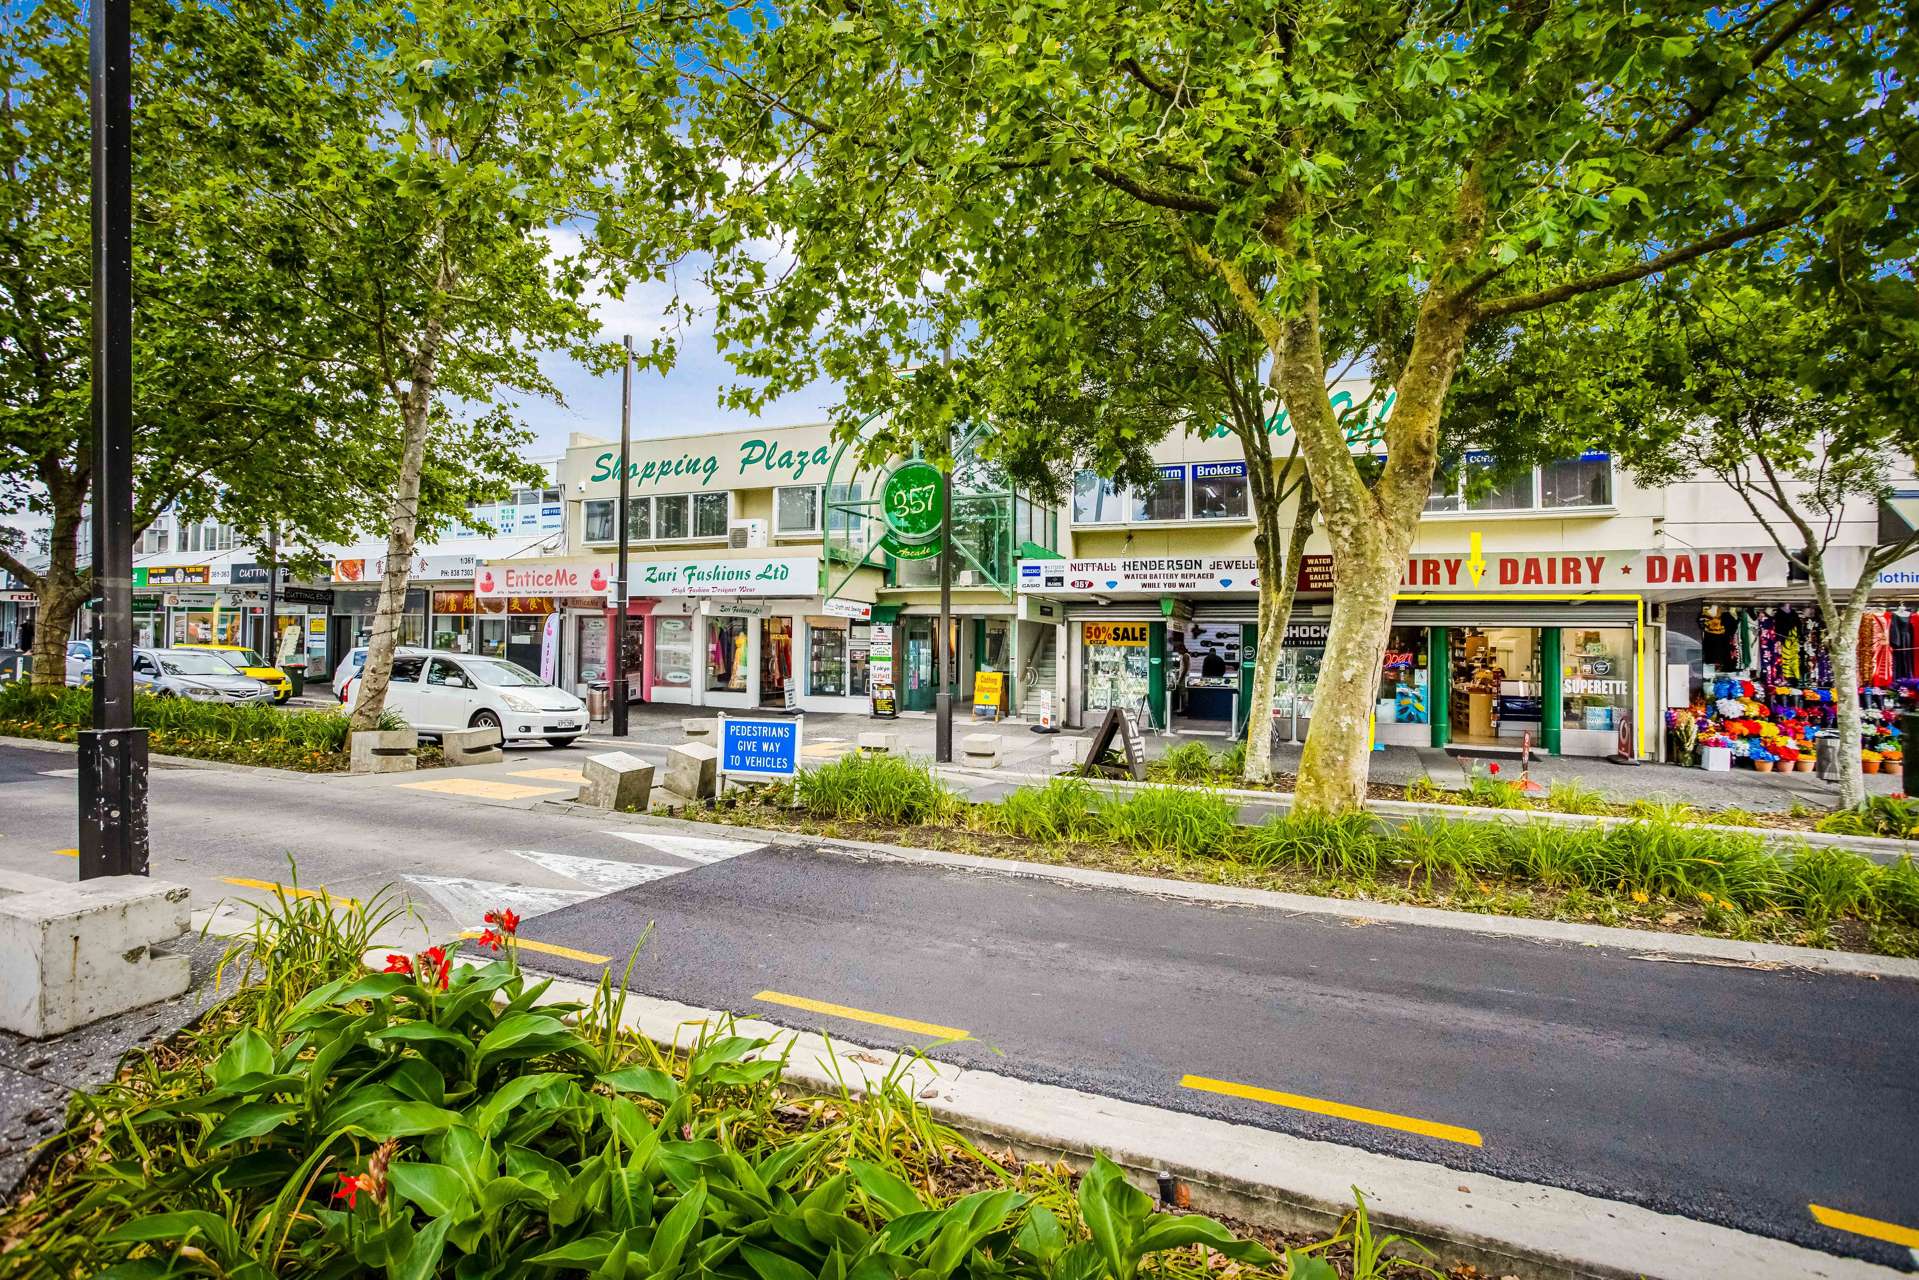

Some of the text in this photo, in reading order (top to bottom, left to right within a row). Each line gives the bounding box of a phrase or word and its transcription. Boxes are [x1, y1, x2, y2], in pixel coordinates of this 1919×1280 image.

[591, 440, 831, 488] Shopping Plaza
[1197, 465, 1242, 476] Brokers
[894, 484, 935, 517] 357
[239, 568, 269, 578] CUTTIN
[1070, 560, 1259, 572] NUTTALL HENDERSON JEWELL
[1401, 553, 1764, 585] IRY DAIRY DAIRY
[506, 568, 578, 588] EnticeMe
[683, 564, 751, 585] Fashions
[756, 563, 789, 580] Ltd
[1086, 626, 1147, 641] 50% SALE
[1564, 679, 1628, 695] SUPERETTE
[730, 725, 790, 738] PEDESTRIANS
[738, 740, 780, 753] GIVE WAY
[730, 755, 788, 769] TO VEHICLES
